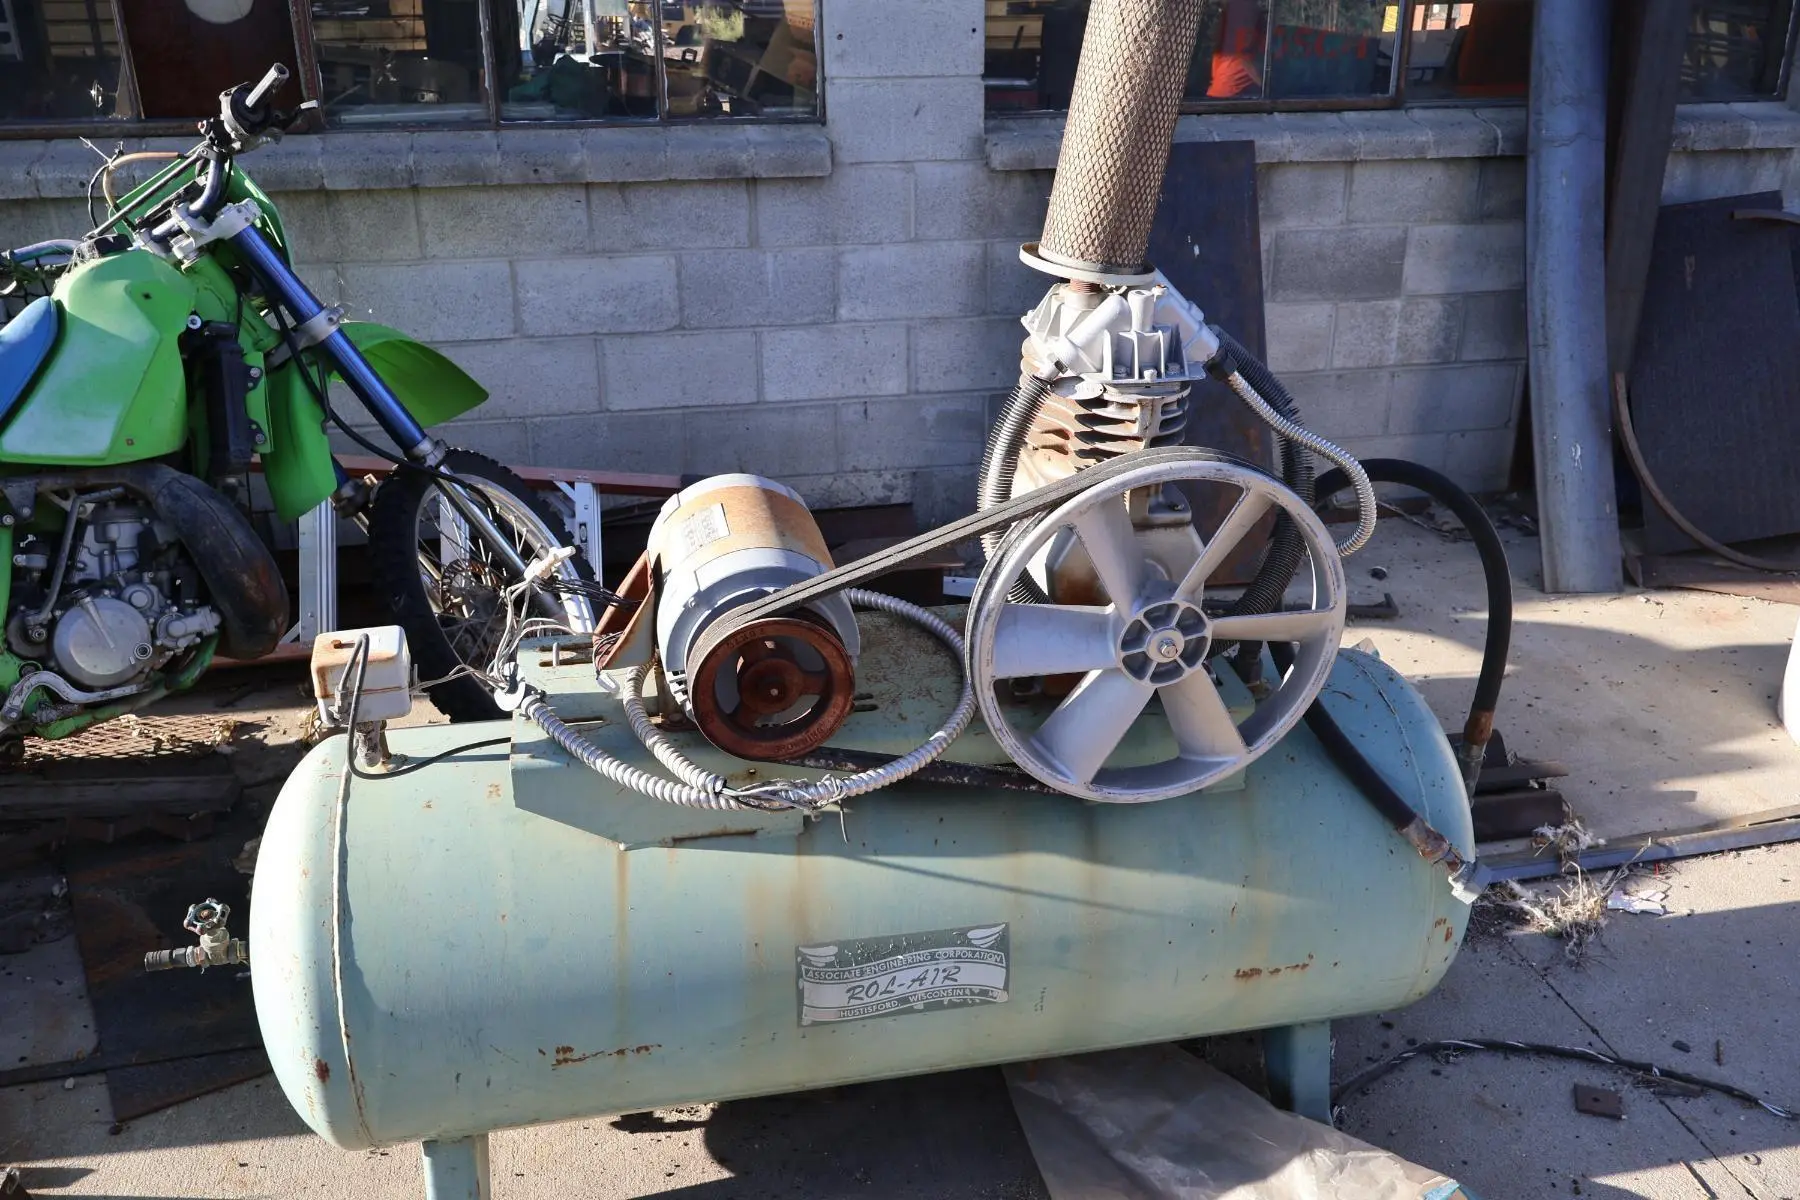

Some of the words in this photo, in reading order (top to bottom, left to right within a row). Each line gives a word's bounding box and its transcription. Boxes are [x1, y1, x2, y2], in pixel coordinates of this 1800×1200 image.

[807, 969, 861, 980] ASSOCIATE
[866, 952, 932, 976] ENGINEERING
[935, 950, 1001, 962] CORPORATION
[845, 965, 961, 1005] ROL-AIR
[908, 988, 964, 1003] WISCONSIN
